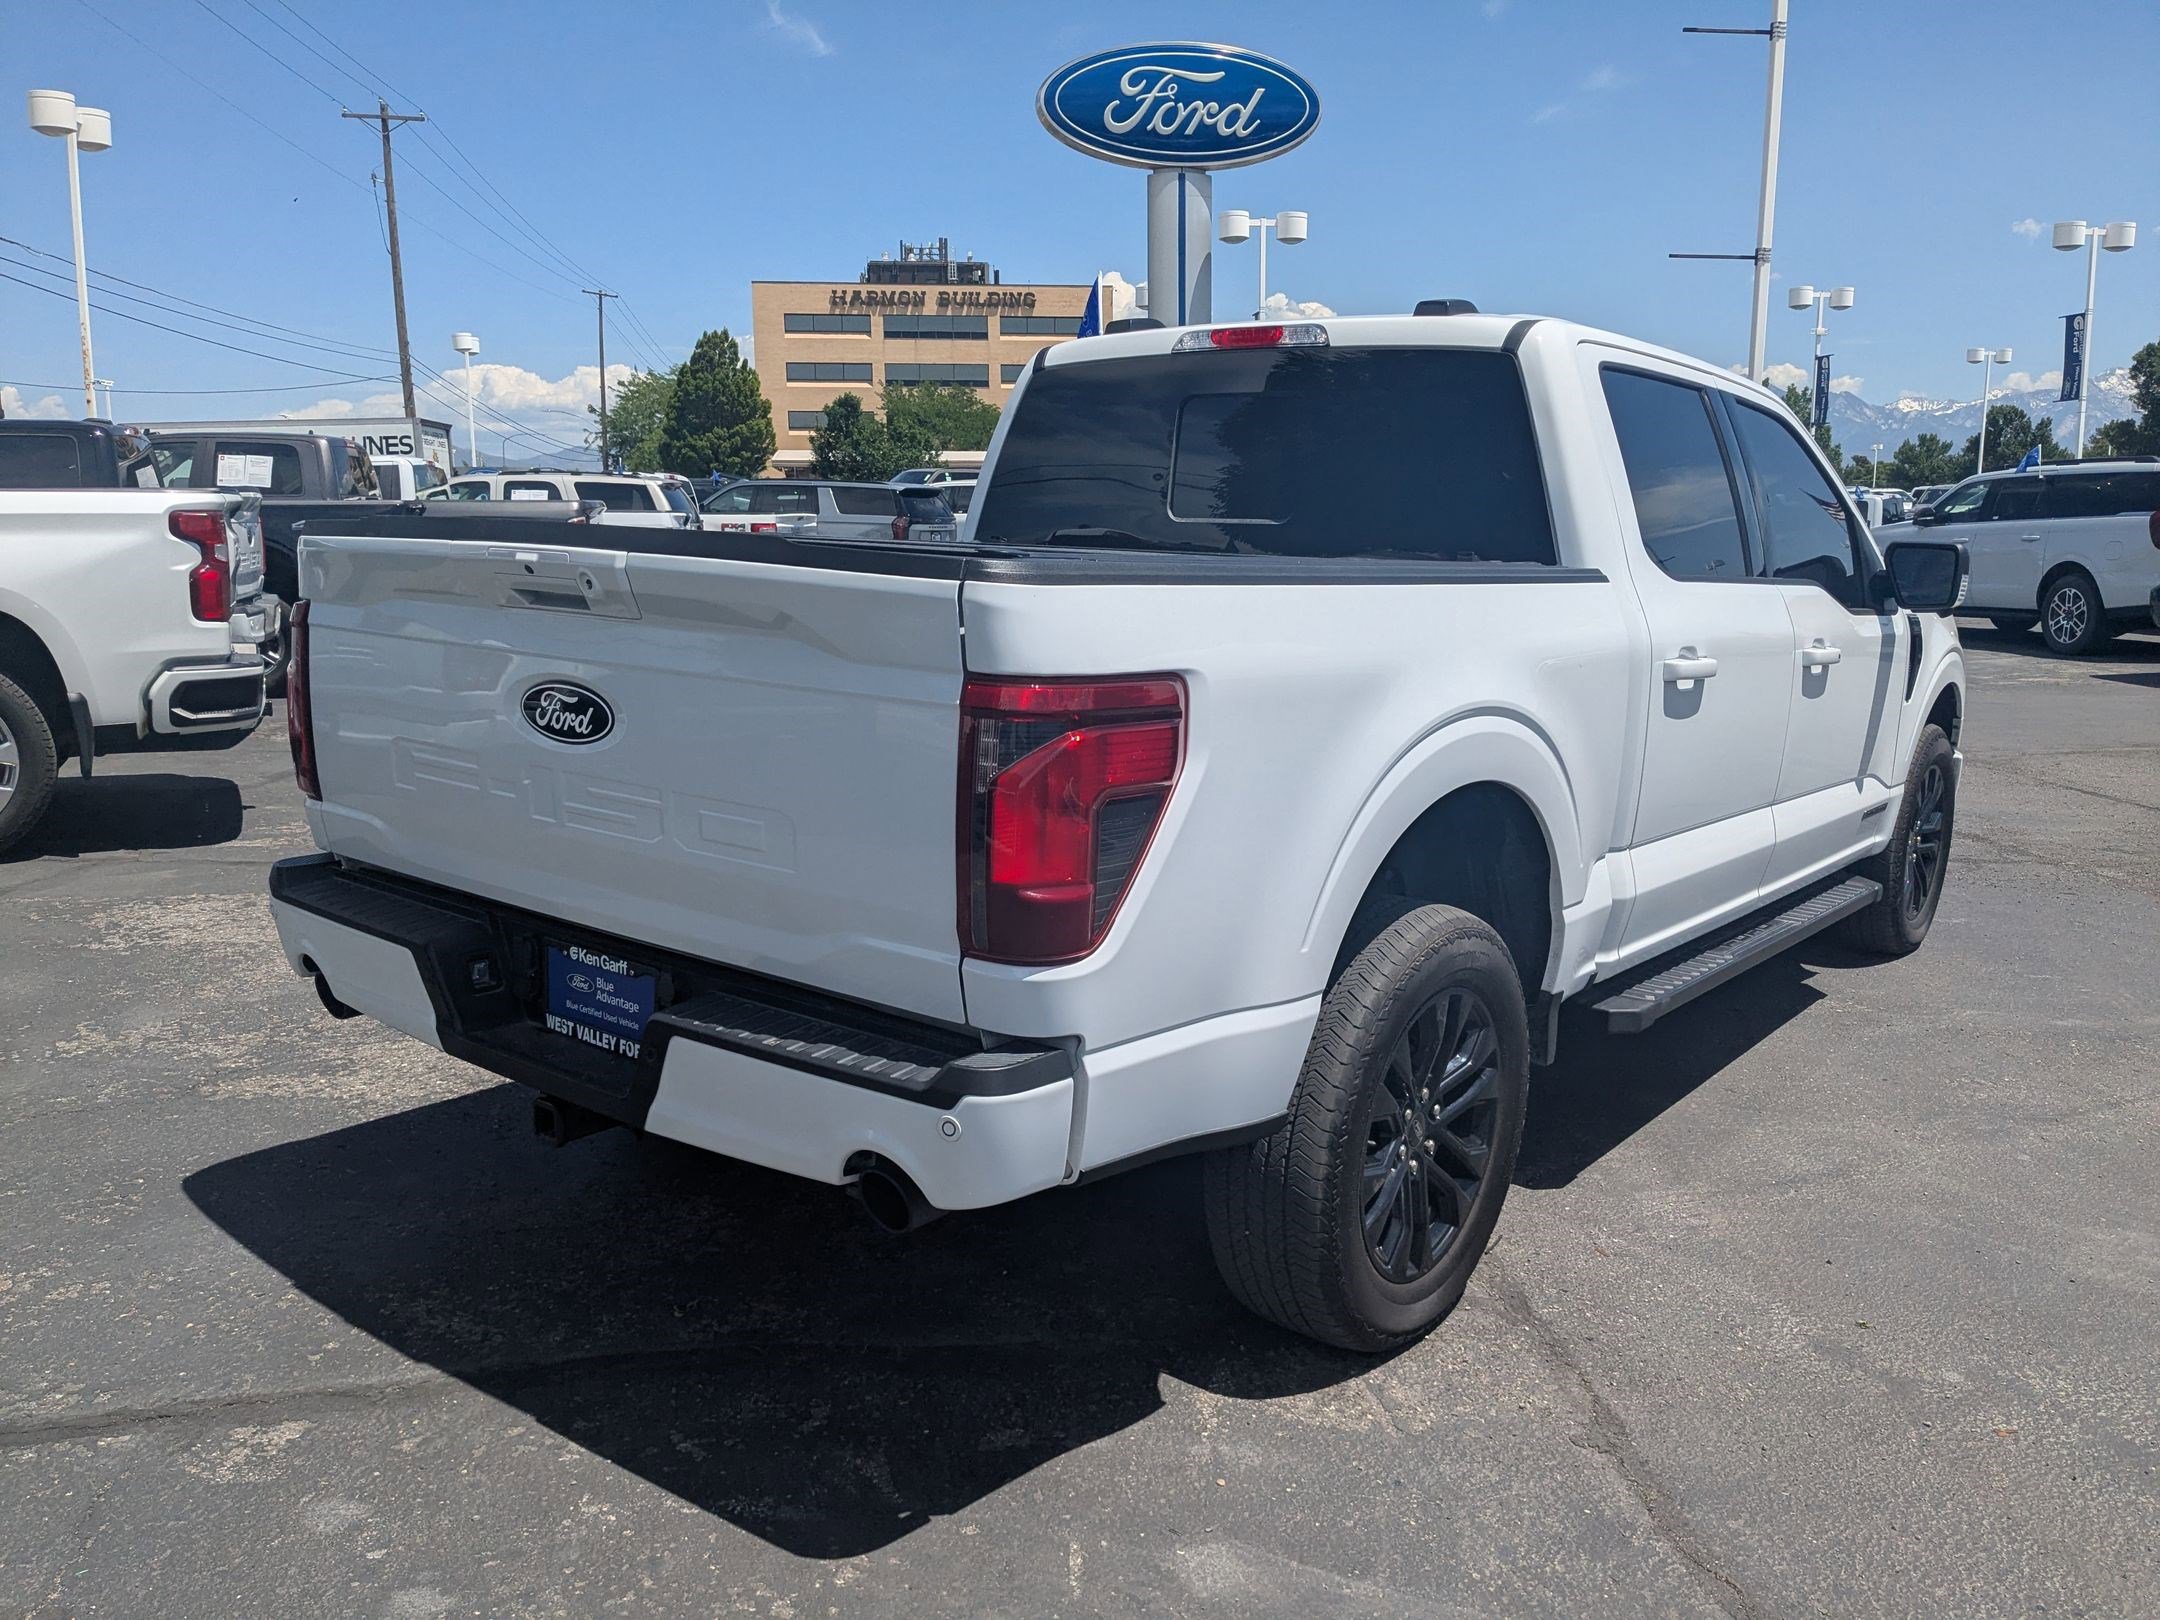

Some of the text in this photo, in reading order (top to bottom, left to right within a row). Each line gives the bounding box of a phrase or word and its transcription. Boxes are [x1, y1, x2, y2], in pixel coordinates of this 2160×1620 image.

[1104, 66, 1265, 138] Ford
[831, 290, 1036, 308] HARMON BUILDING
[536, 690, 594, 735] Ford
[392, 736, 797, 874] F-150
[579, 948, 628, 976] Ken Garff
[572, 975, 590, 990] Ford
[596, 977, 615, 992] Blue
[566, 1000, 639, 1031] Blue Certified Used Vehicle
[596, 990, 640, 1013] Advantage
[546, 1013, 574, 1037] WEST
[576, 1023, 617, 1051] VALLEY
